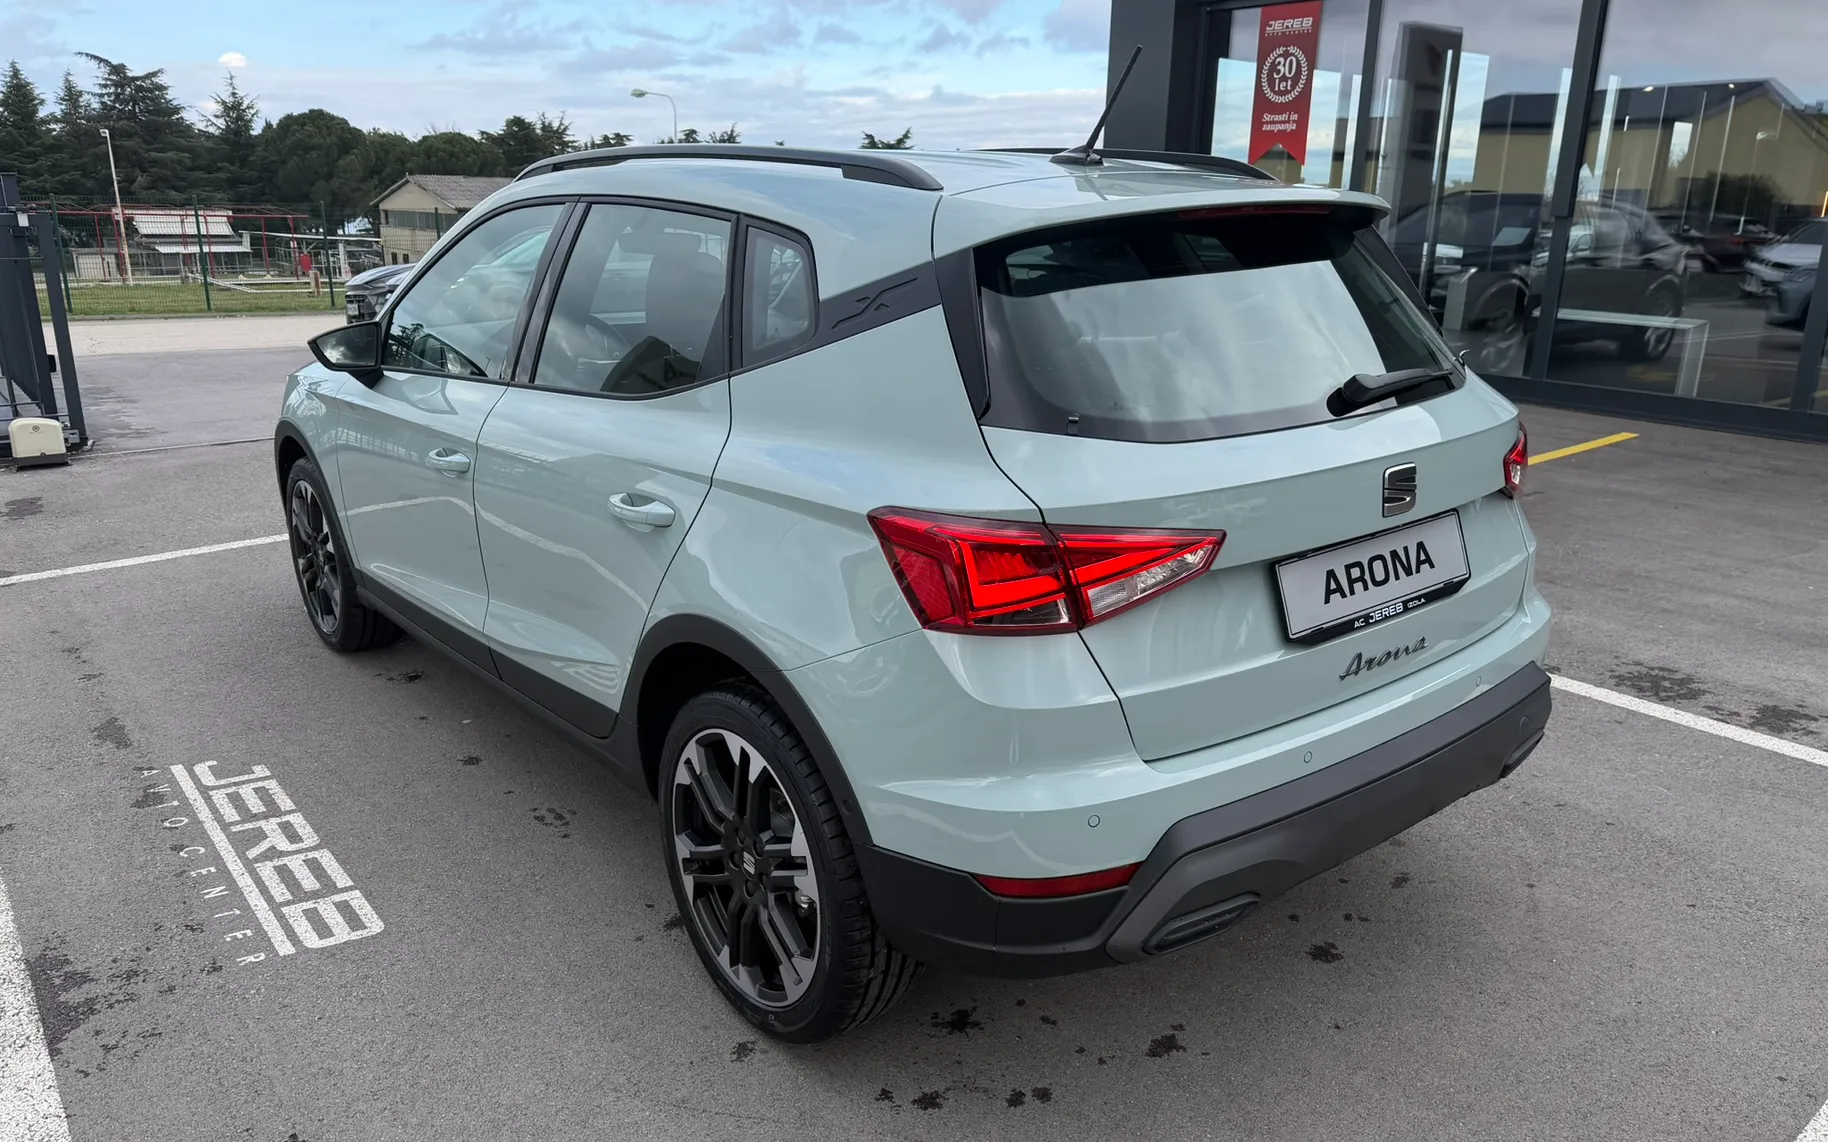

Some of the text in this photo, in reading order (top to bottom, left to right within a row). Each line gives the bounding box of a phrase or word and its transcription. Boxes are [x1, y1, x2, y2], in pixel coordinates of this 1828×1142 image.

[1266, 17, 1313, 30] JEREB
[1273, 56, 1296, 78] 30
[1274, 79, 1292, 91] let
[1262, 111, 1298, 122] Strasti in
[1262, 121, 1297, 133] zaupanja
[1323, 540, 1436, 605] ARONA
[1353, 618, 1366, 629] AC
[1369, 602, 1404, 623] JEREB
[1338, 635, 1430, 681] Arona
[192, 760, 385, 948] JEREB
